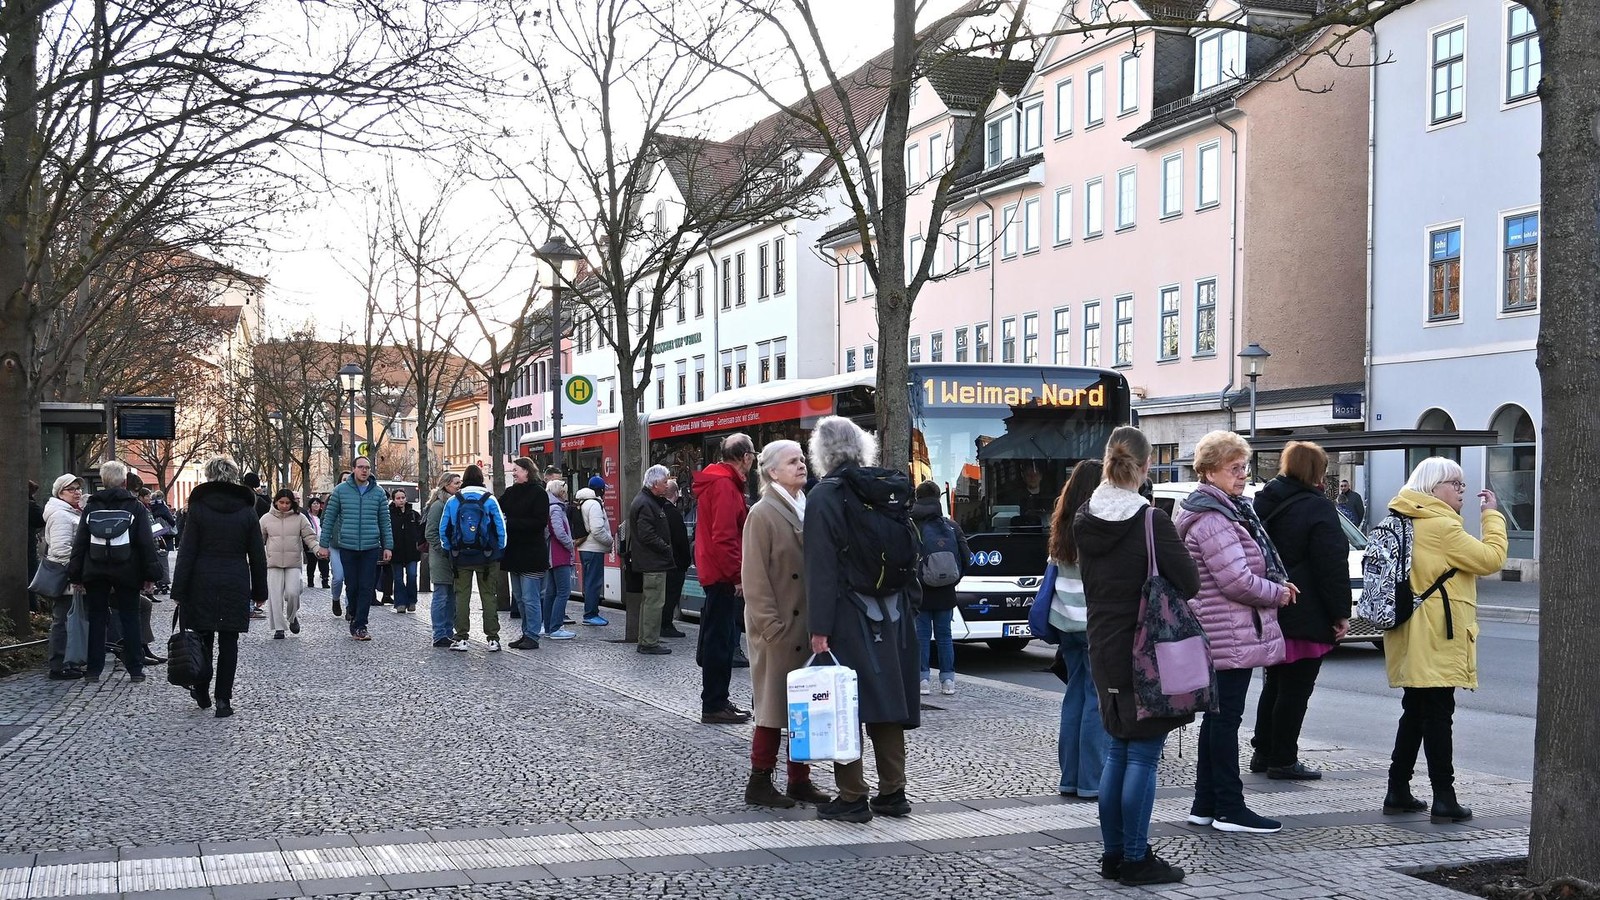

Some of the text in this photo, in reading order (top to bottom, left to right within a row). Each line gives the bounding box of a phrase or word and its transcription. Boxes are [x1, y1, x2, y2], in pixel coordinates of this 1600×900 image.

[924, 378, 1104, 406] 1 Weimar Nord
[1005, 597, 1035, 607] MA
[1009, 625, 1020, 635] WE
[812, 690, 830, 701] seni
